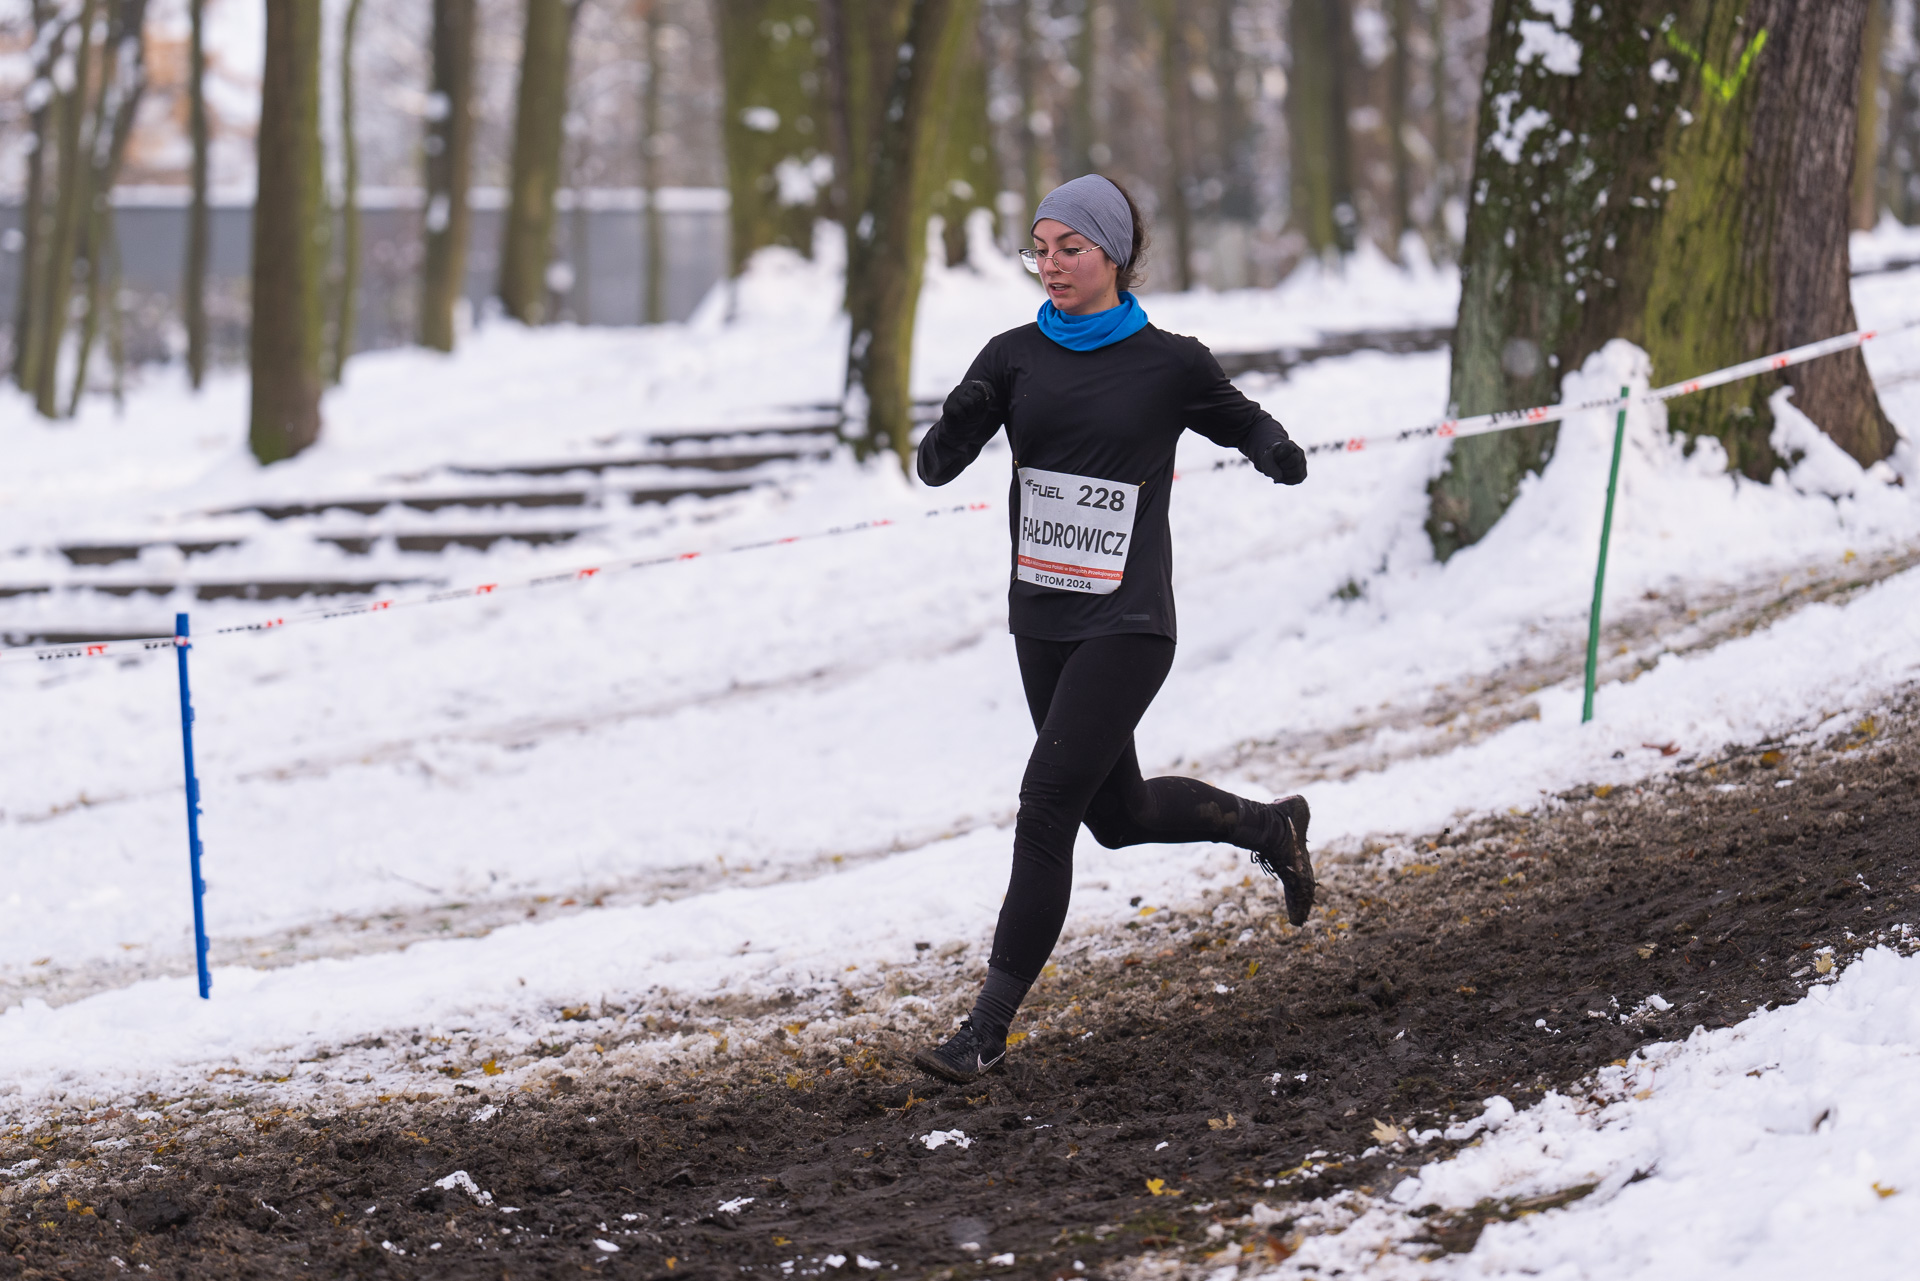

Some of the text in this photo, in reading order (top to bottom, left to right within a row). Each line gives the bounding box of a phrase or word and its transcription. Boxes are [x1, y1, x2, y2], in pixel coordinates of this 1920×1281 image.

[1032, 484, 1065, 500] FUEL
[1077, 485, 1125, 512] 228
[1022, 516, 1127, 557] FAŁDROWICZ
[1035, 573, 1092, 590] BYTOM 2024
